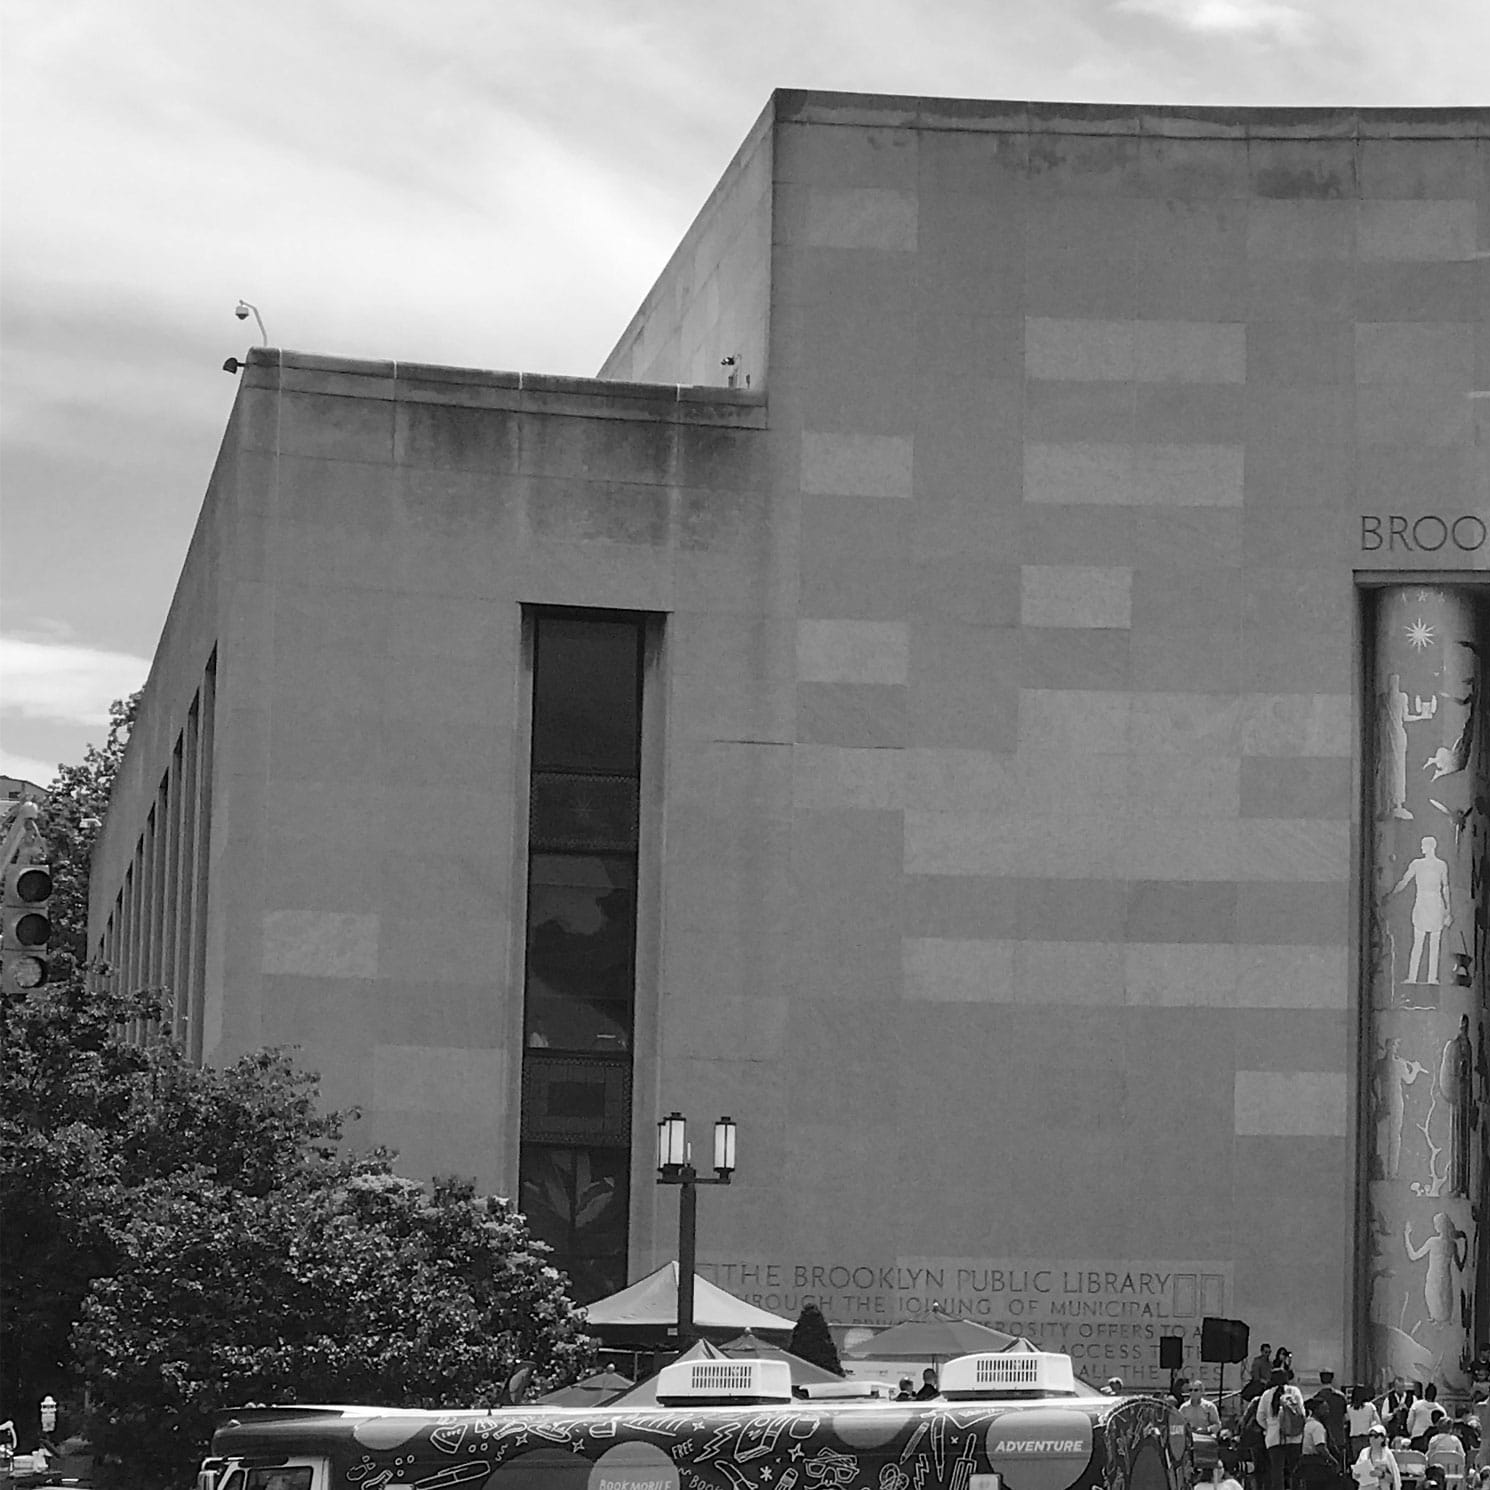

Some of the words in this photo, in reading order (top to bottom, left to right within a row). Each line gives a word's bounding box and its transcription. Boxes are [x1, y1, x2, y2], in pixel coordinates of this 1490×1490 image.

[721, 1263, 781, 1287] THE
[794, 1265, 945, 1291] BROOKLYN
[957, 1269, 1052, 1294] PUBLIC
[1063, 1271, 1172, 1295] LIBRARY
[841, 1295, 886, 1313] THE
[1008, 1298, 1039, 1316] OF
[1050, 1300, 1169, 1319] MUNICIPAL
[1078, 1323, 1154, 1340] OFFERS
[1160, 1325, 1186, 1338] TO
[1059, 1344, 1143, 1360] ACCESS
[1079, 1363, 1113, 1380] ALL
[1119, 1364, 1158, 1380] THE
[671, 1438, 694, 1459] FREE
[994, 1440, 1084, 1452] ADVENTURE
